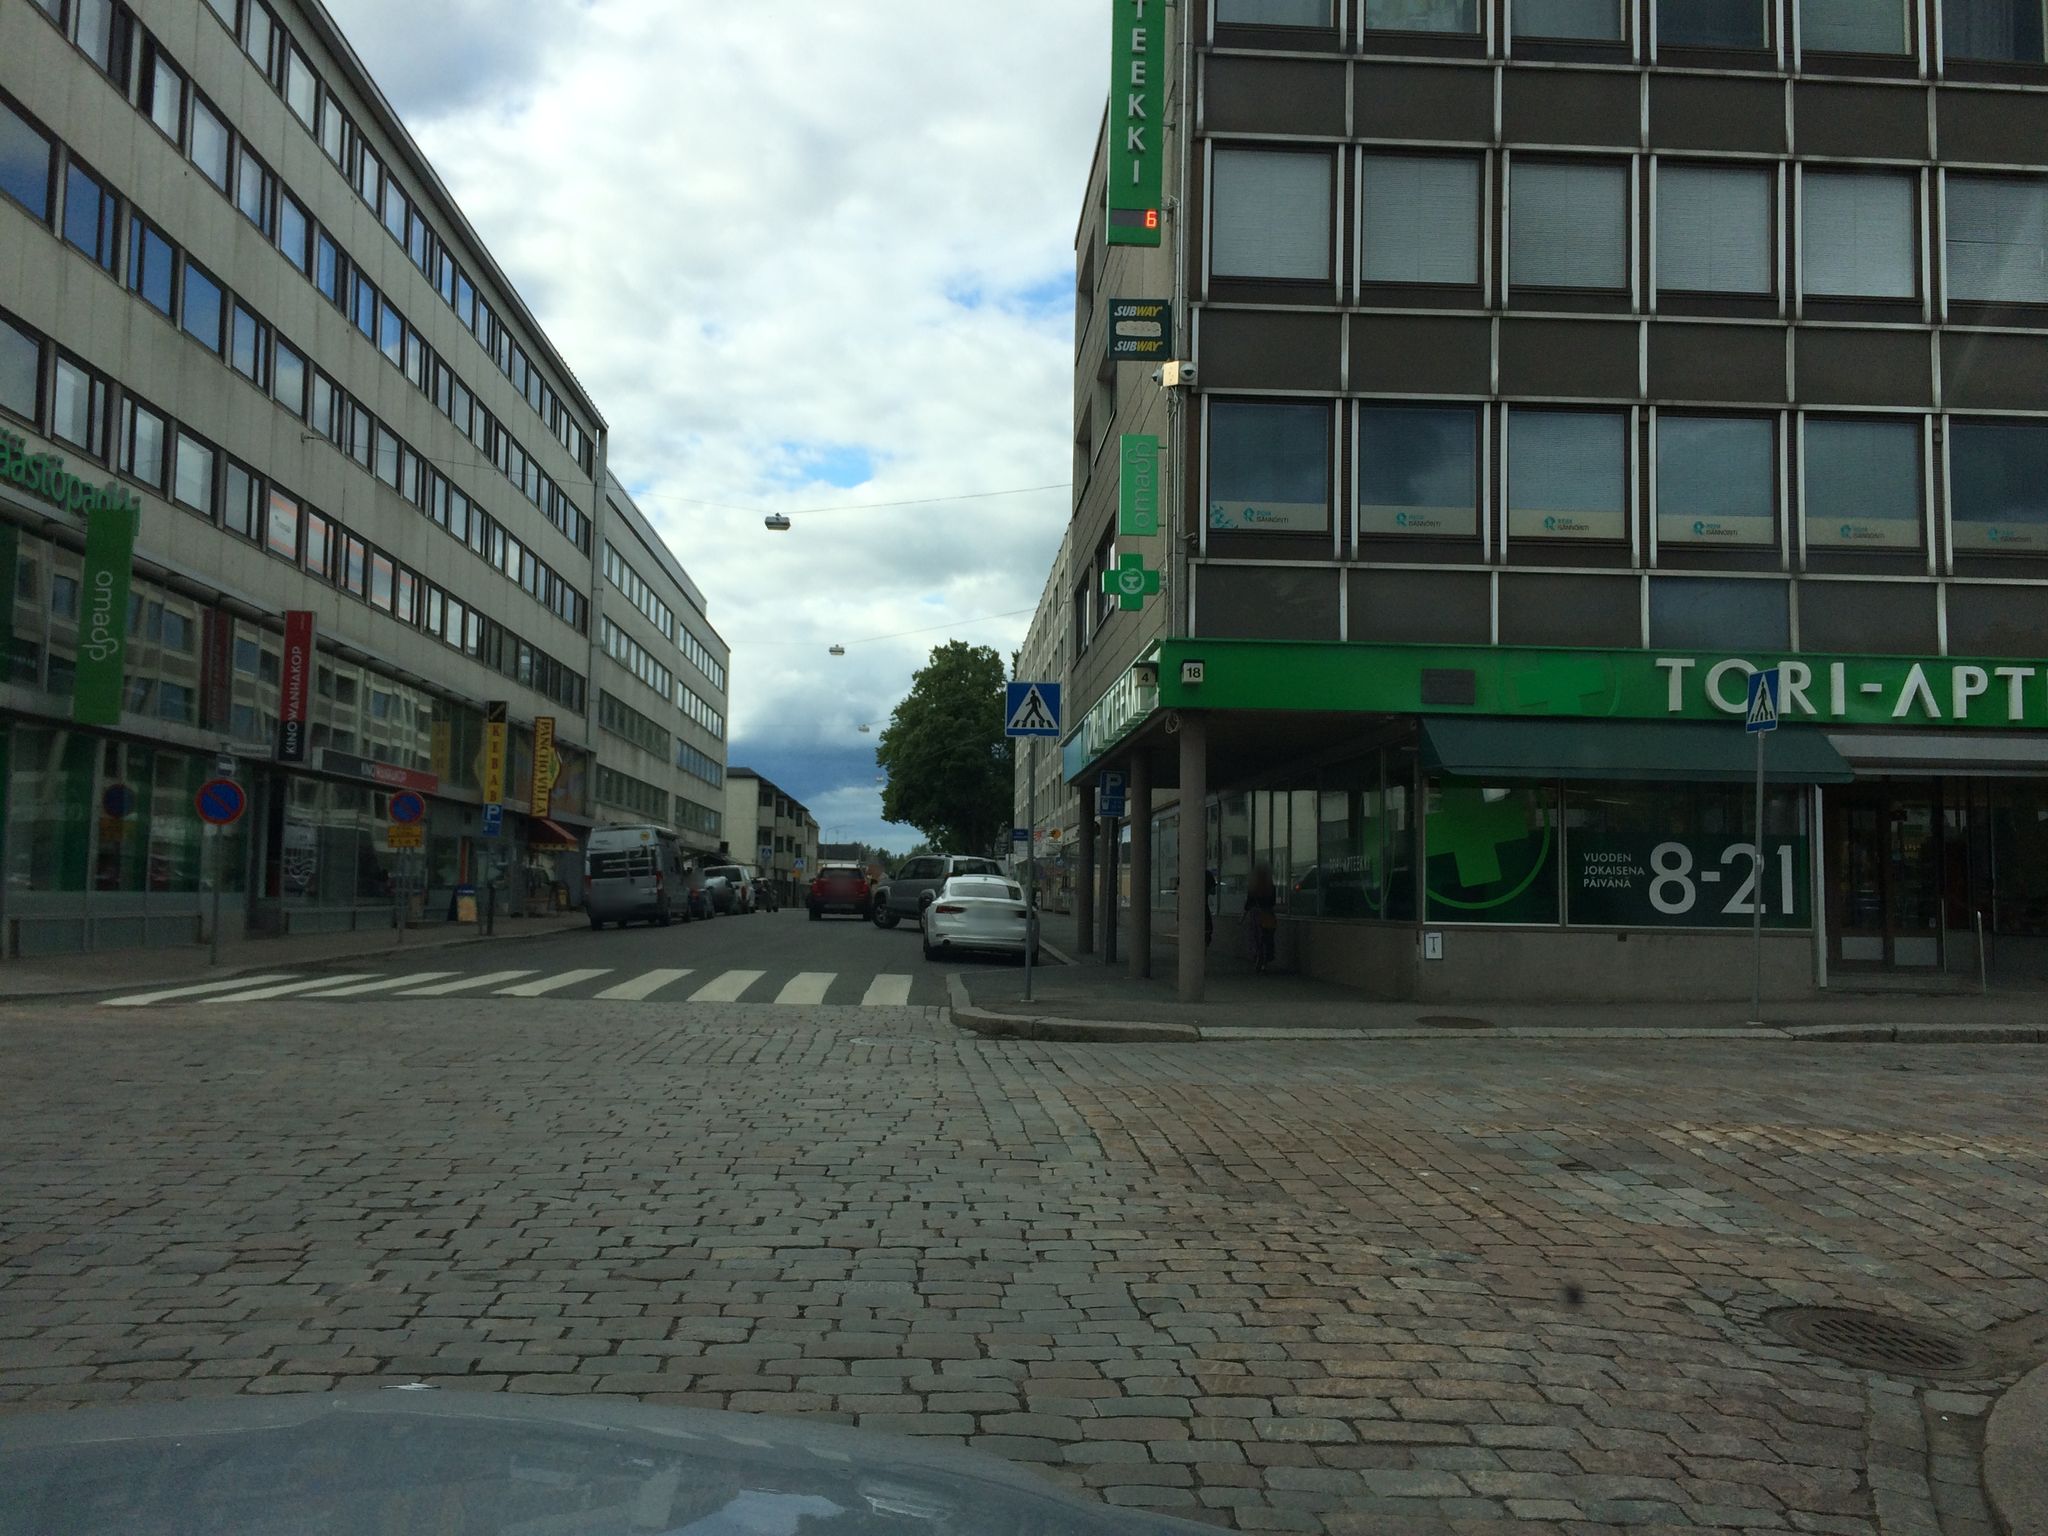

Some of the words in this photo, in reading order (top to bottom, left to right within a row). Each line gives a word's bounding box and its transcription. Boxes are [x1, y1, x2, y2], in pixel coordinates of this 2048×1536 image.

[1145, 210, 1157, 228] 6
[1114, 305, 1162, 317] SUBWAY
[1114, 341, 1162, 353] SUBWAY
[1141, 672, 1149, 683] 4
[1186, 666, 1201, 679] 18
[1655, 657, 2048, 721] TORI-APT
[488, 725, 500, 803] KEBAB
[487, 804, 501, 820] P
[1583, 852, 1632, 864] VUODEN
[1583, 865, 1646, 877] JOKAISENA
[1583, 877, 1632, 889] PÄIVÄNÄ
[1648, 841, 1794, 915] 8-21
